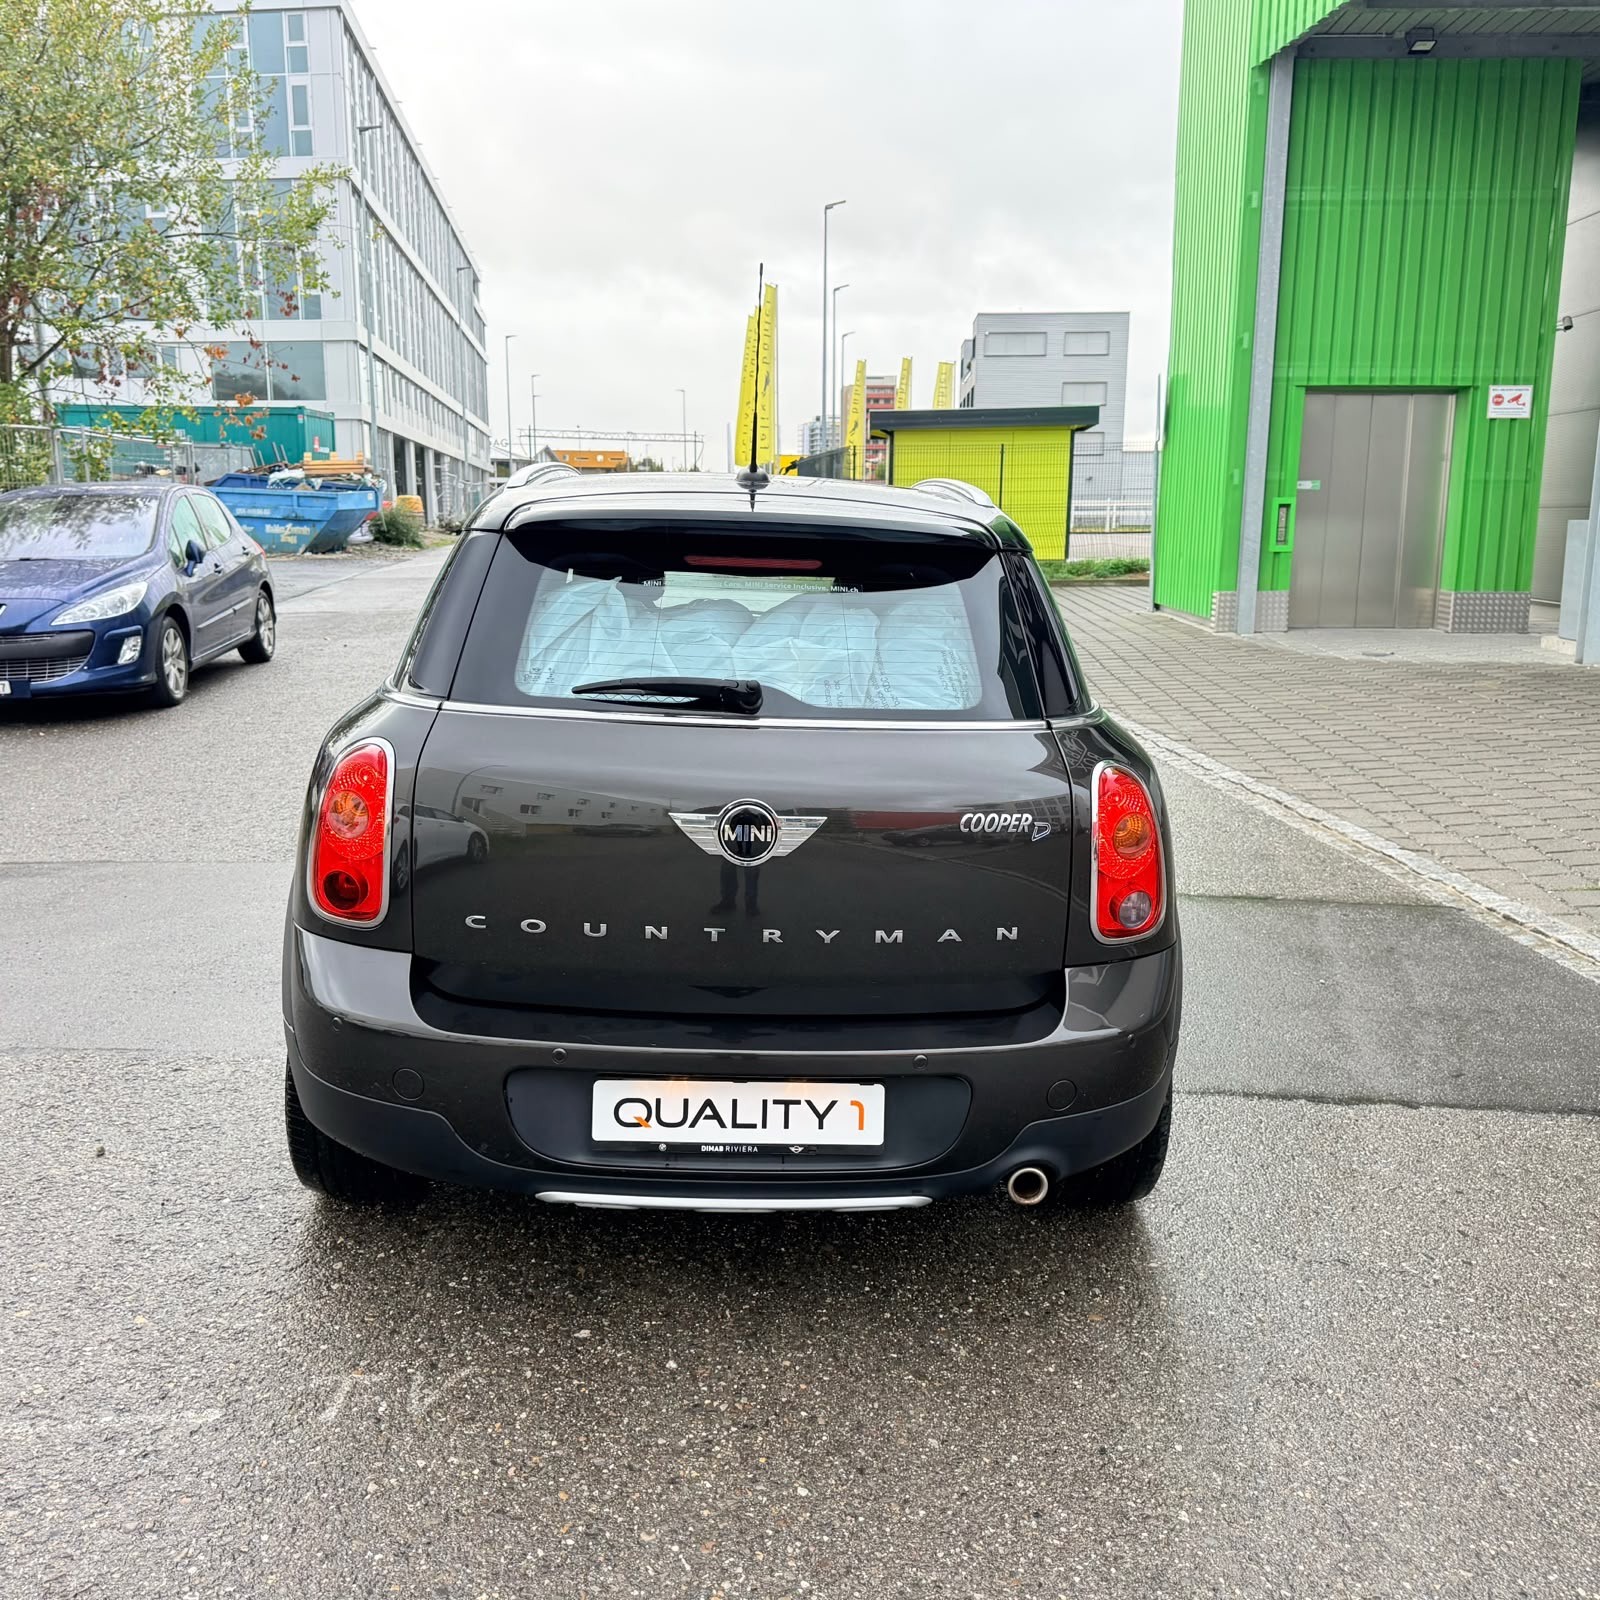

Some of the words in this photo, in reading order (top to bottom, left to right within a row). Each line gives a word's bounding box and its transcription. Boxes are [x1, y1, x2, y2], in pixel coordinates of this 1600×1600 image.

[765, 582, 792, 590] Service
[830, 585, 859, 593] MINI.ch
[723, 824, 772, 842] MINI
[959, 812, 1033, 833] COOPER
[1031, 821, 1052, 842] D
[464, 914, 1019, 944] COUNTRYMAN
[613, 1097, 838, 1130] QUALITY
[850, 1100, 865, 1131] 1
[725, 1145, 759, 1153] RIVIERA
